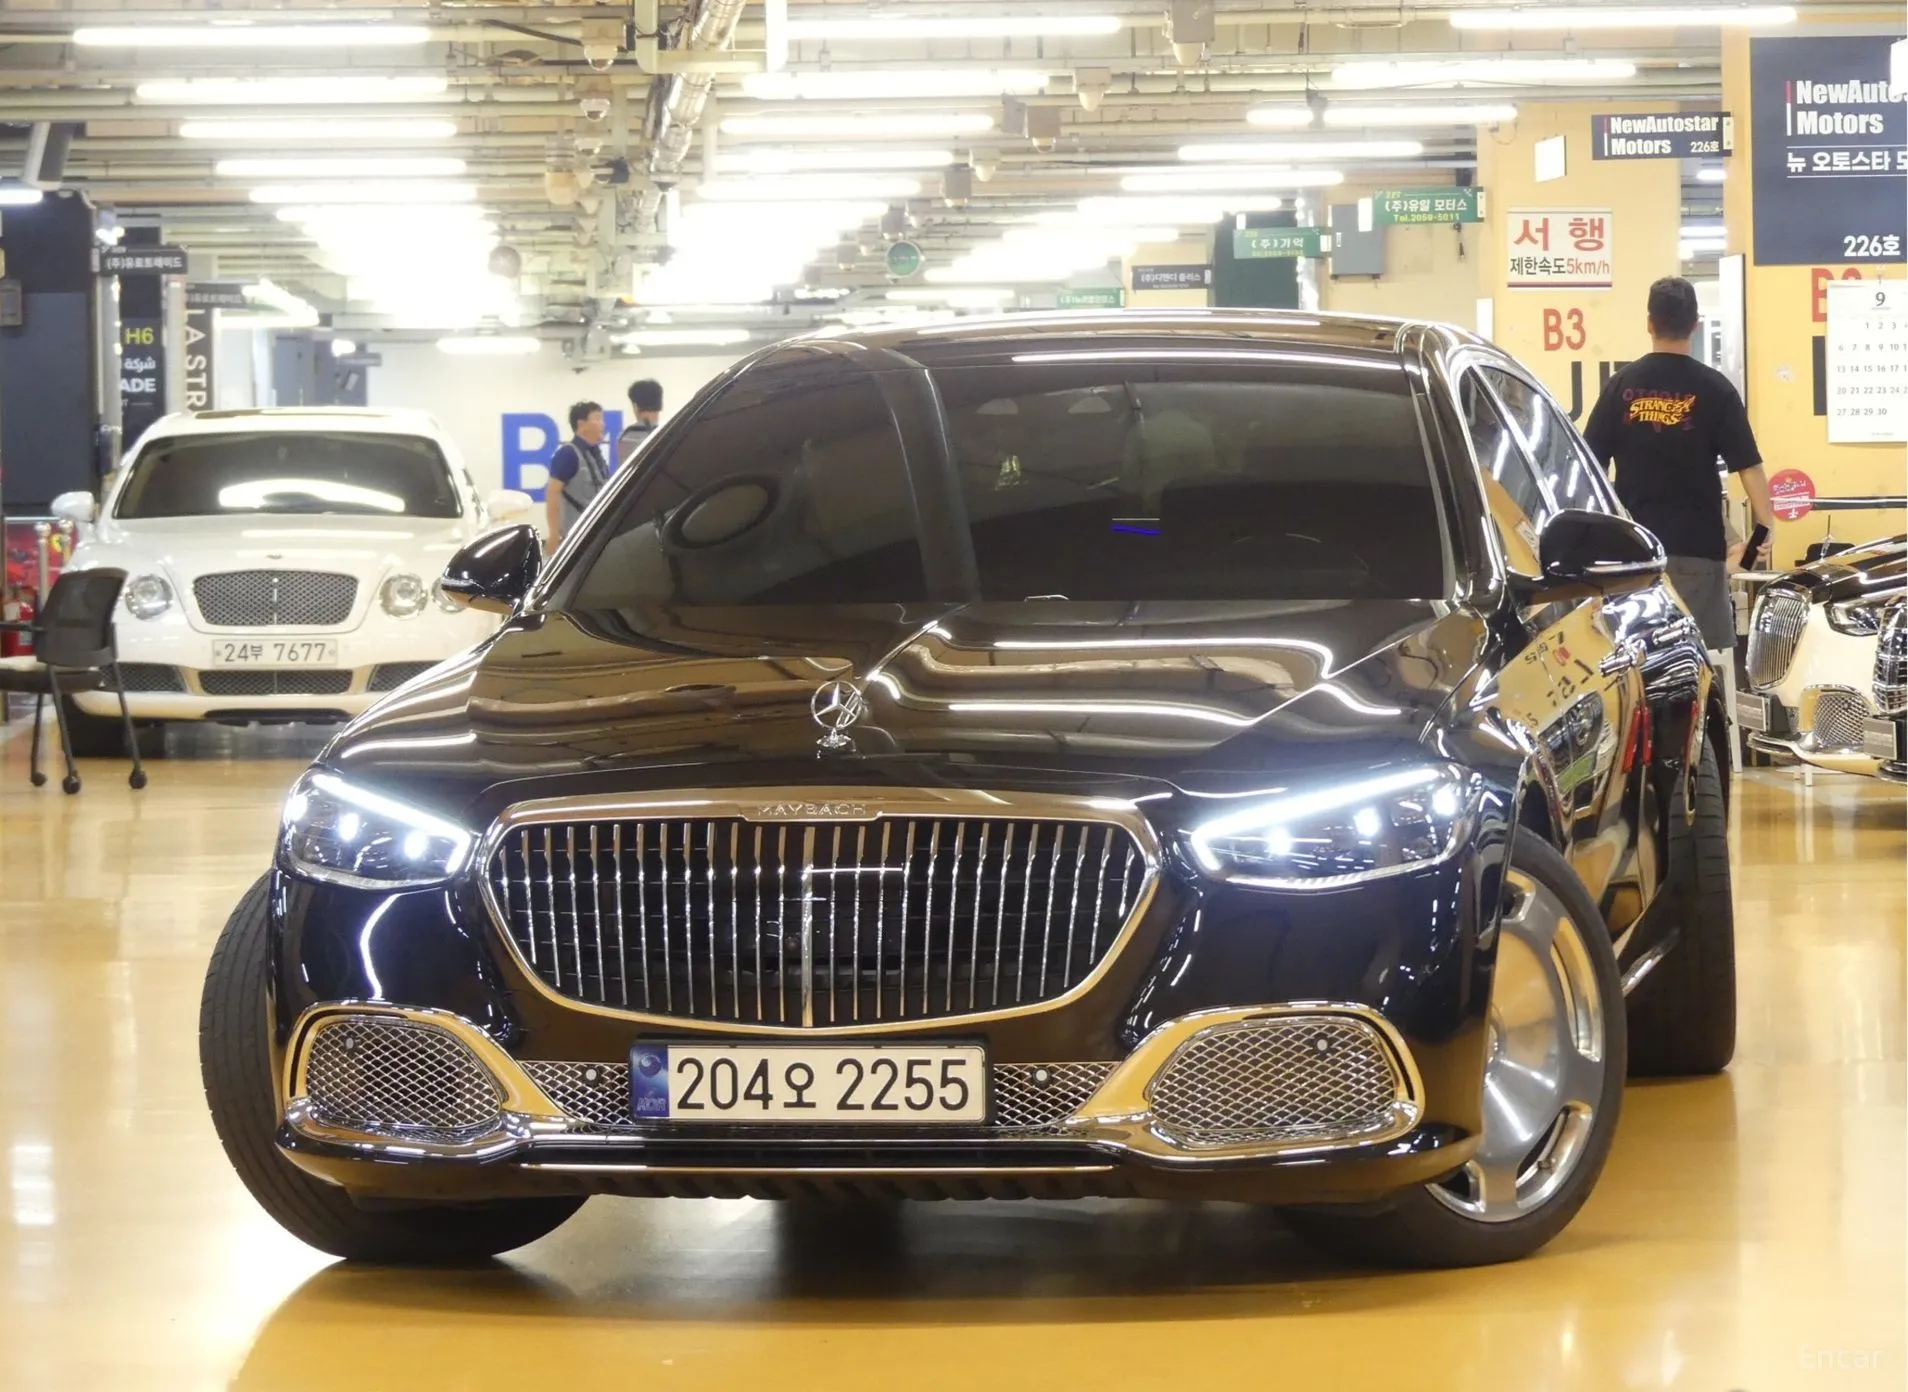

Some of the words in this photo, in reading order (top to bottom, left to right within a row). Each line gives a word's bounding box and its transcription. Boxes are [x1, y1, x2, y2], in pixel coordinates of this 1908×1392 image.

[1796, 79, 1907, 104] NewAut
[1610, 115, 1719, 134] NewAutostar
[1797, 111, 1884, 135] Motors
[1611, 138, 1672, 155] Motors
[1690, 141, 1720, 153] 226호
[1787, 152, 1806, 173] 뉴
[1812, 151, 1891, 171] 오토스타
[1434, 199, 1468, 211] 모터스
[1843, 234, 1901, 257] 226호
[1811, 267, 1862, 322] B
[1875, 291, 1886, 307] 9
[125, 328, 154, 344] H6
[1543, 308, 1586, 351] B3
[1837, 365, 1846, 373] 13
[1850, 365, 1860, 373] 14
[1863, 365, 1873, 373] 15
[1877, 365, 1886, 373] 16
[1890, 365, 1899, 373] 17
[1837, 387, 1847, 395] 20
[1850, 387, 1860, 395] 21
[1863, 387, 1874, 395] 22
[1877, 387, 1887, 395] 23
[1890, 387, 1900, 395] 24
[1630, 396, 1696, 419] STRANGER
[1837, 408, 1847, 416] 27
[1850, 408, 1860, 416] 28
[1863, 408, 1874, 416] 29
[1877, 408, 1887, 416] 30
[1639, 411, 1684, 425] THINGS
[224, 643, 263, 662] 24부
[274, 643, 326, 661] 7677
[758, 803, 866, 816] MAYBACH
[677, 1058, 816, 1110] 204오
[836, 1058, 969, 1110] 2255
